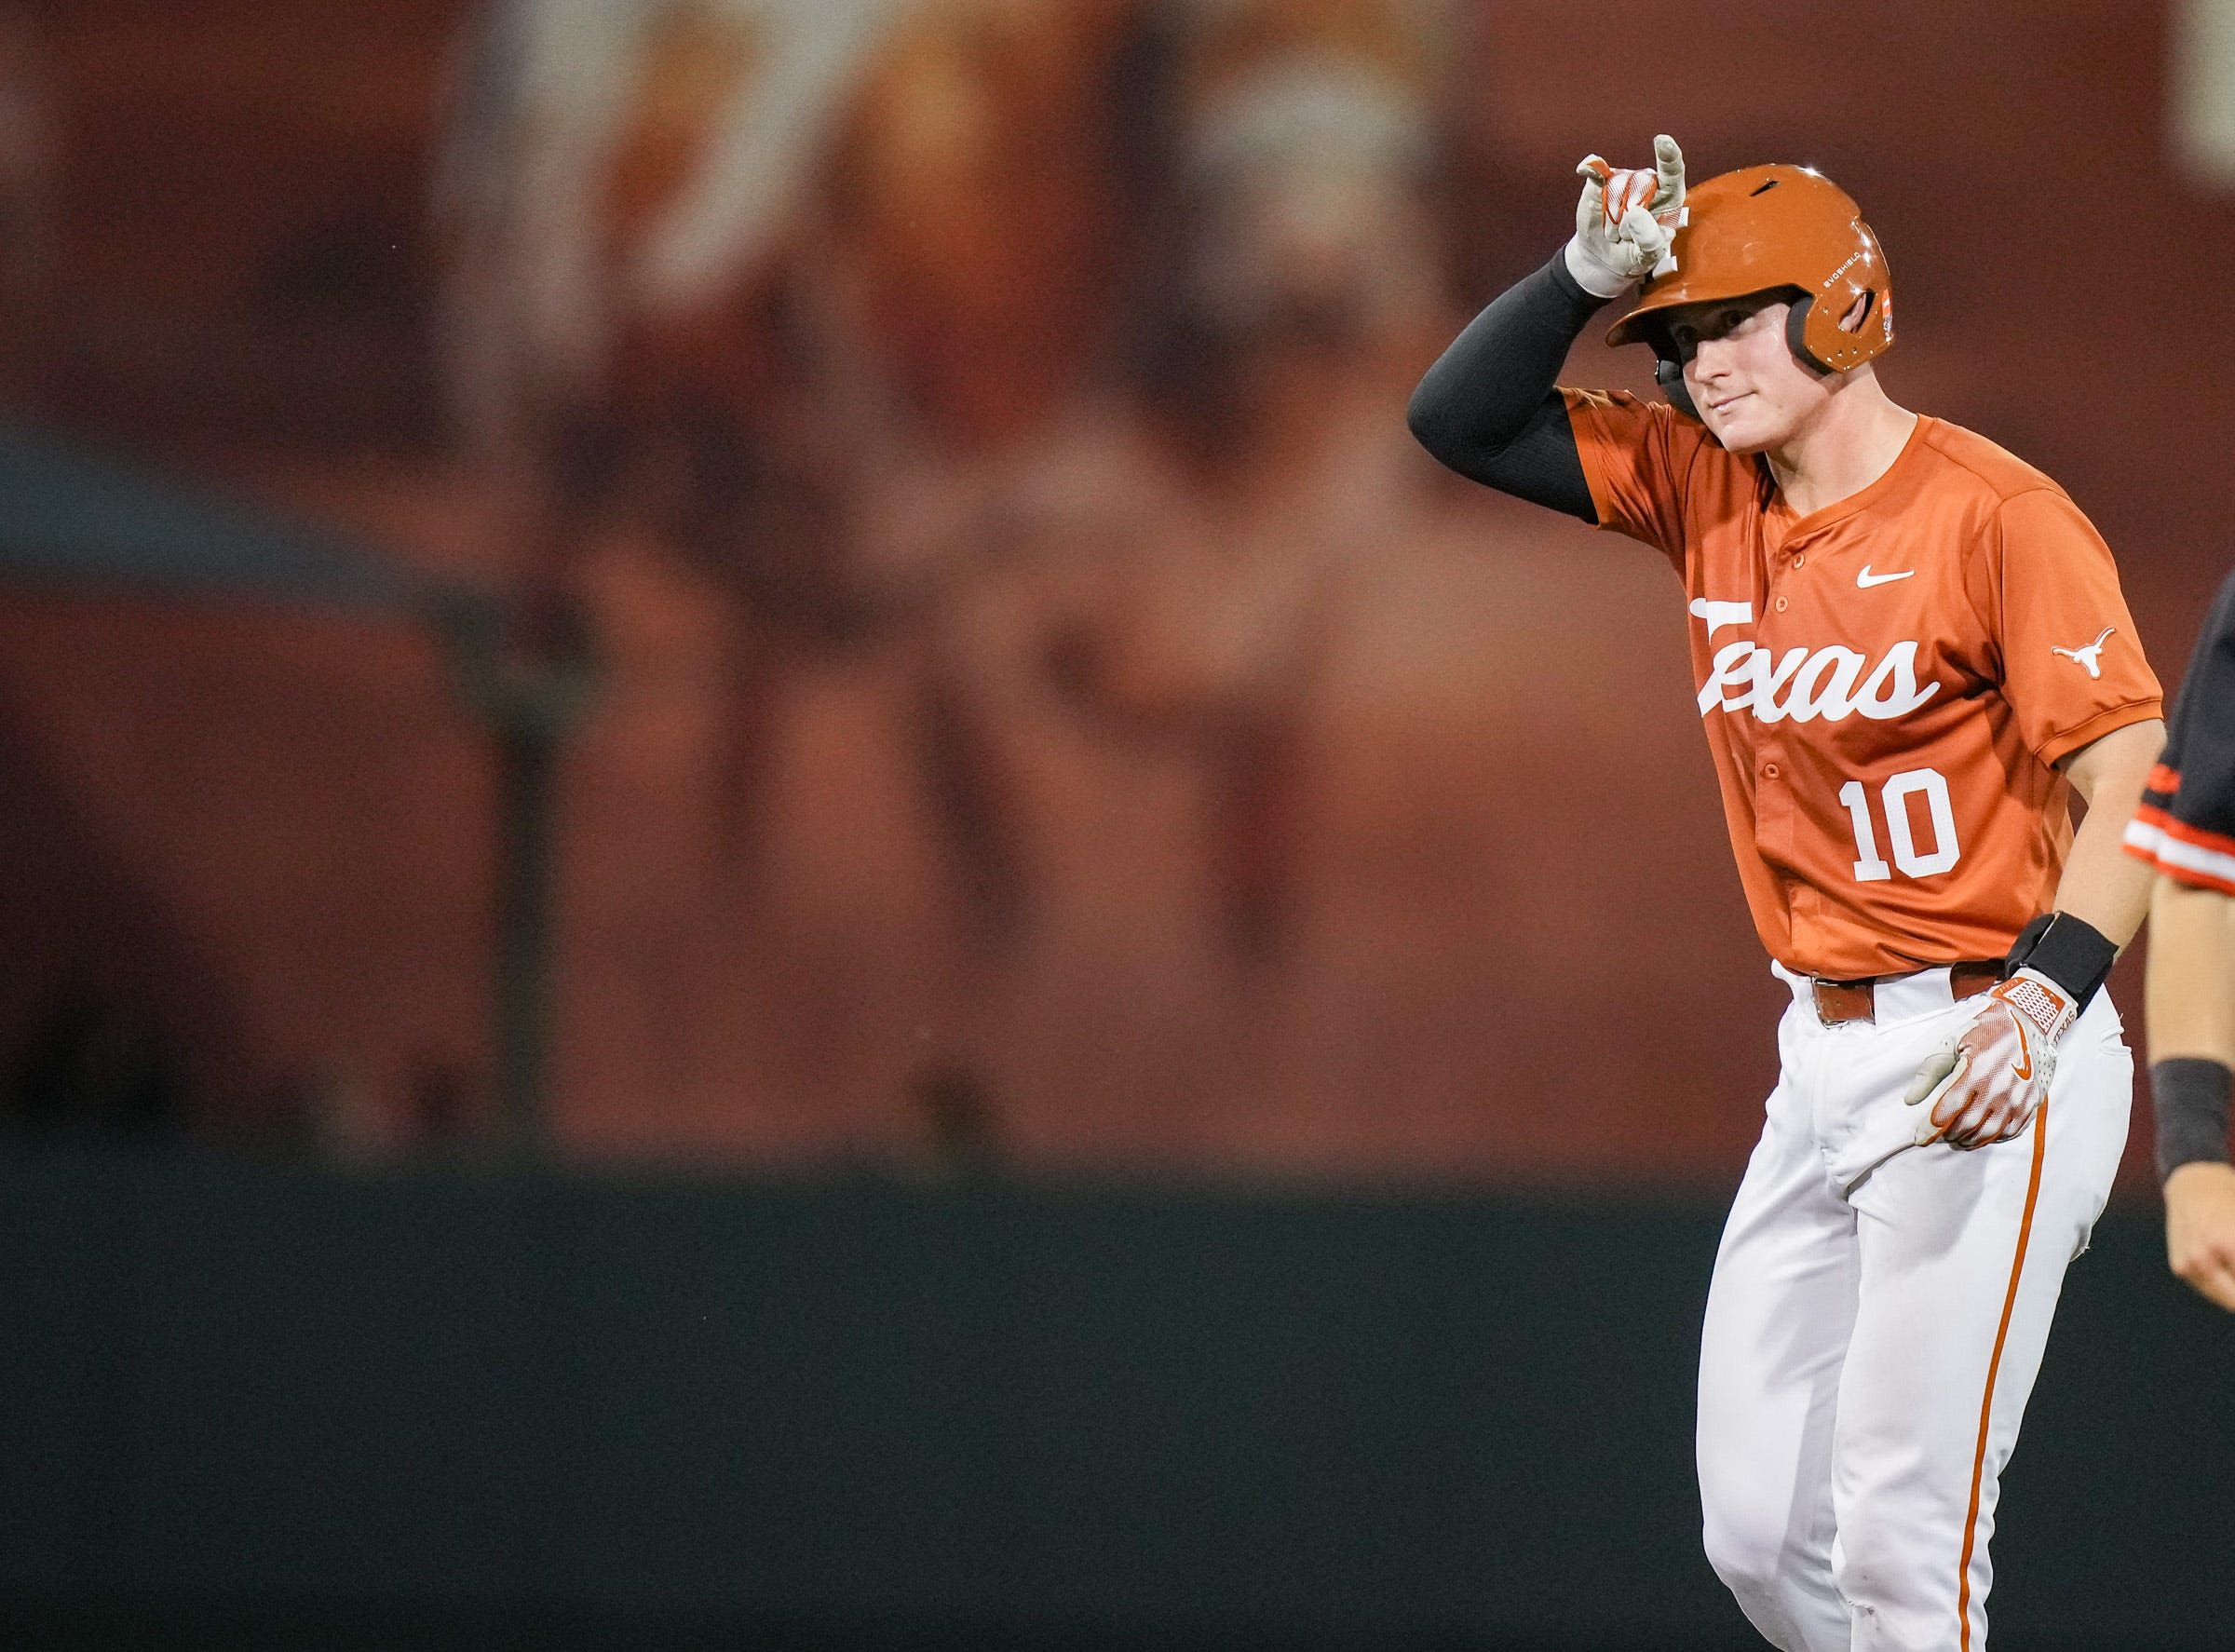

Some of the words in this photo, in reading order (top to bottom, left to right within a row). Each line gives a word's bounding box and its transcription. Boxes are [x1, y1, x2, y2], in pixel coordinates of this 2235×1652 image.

[1689, 597, 1941, 724] Texas
[1838, 767, 1961, 882] 10
[2053, 1009, 2076, 1047] TEXAS
